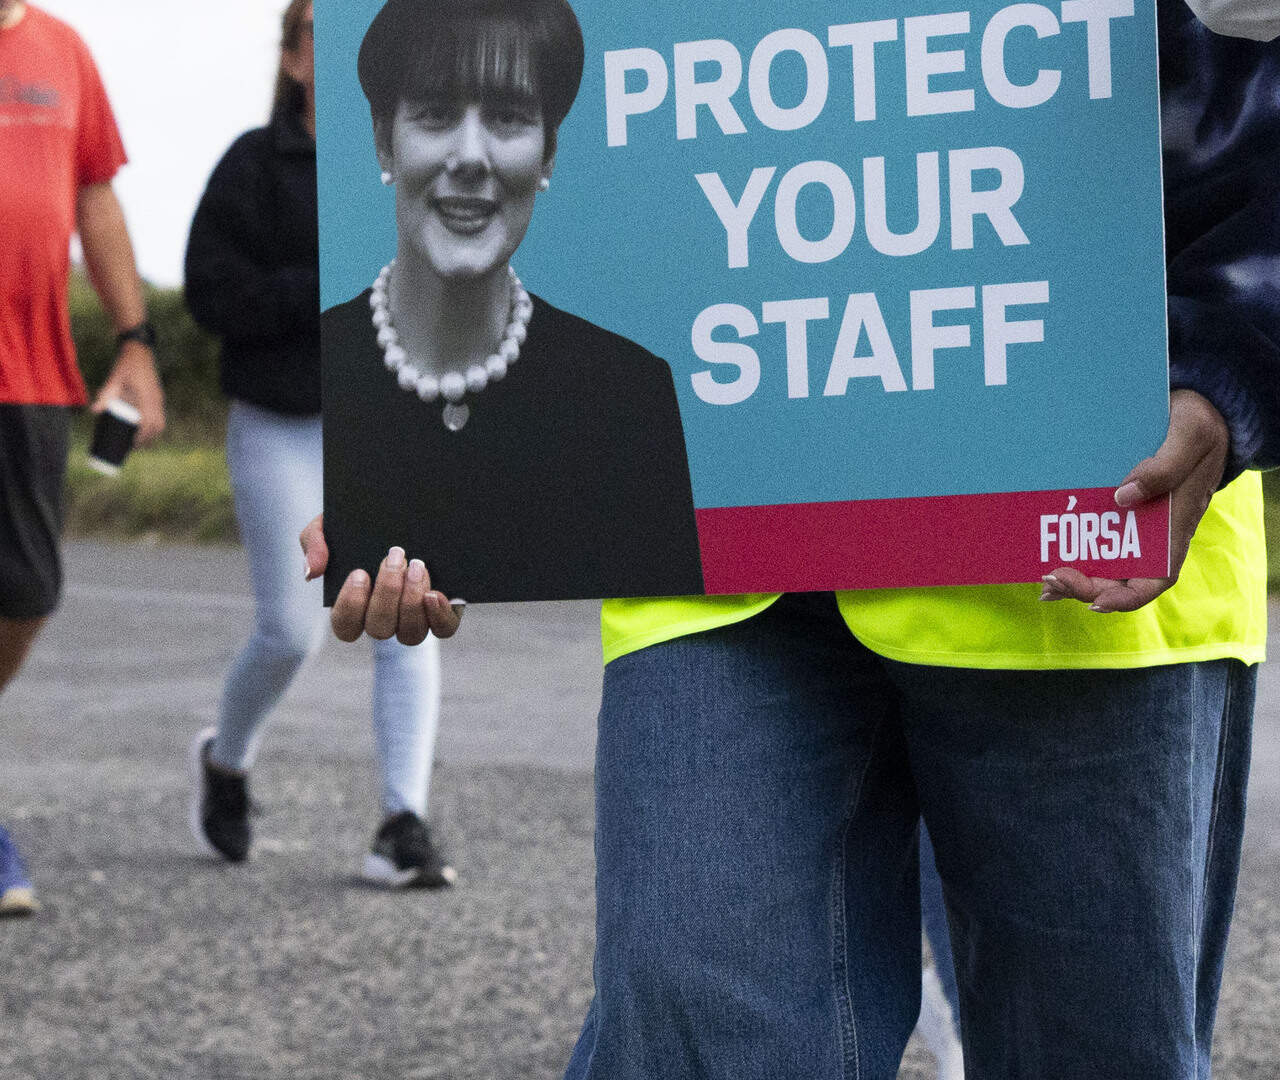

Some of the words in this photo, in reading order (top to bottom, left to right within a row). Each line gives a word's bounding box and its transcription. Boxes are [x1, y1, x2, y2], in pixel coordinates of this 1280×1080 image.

[695, 146, 1030, 269] YOUR
[690, 280, 1050, 406] STAFF
[1039, 495, 1141, 563] FÓRSA
